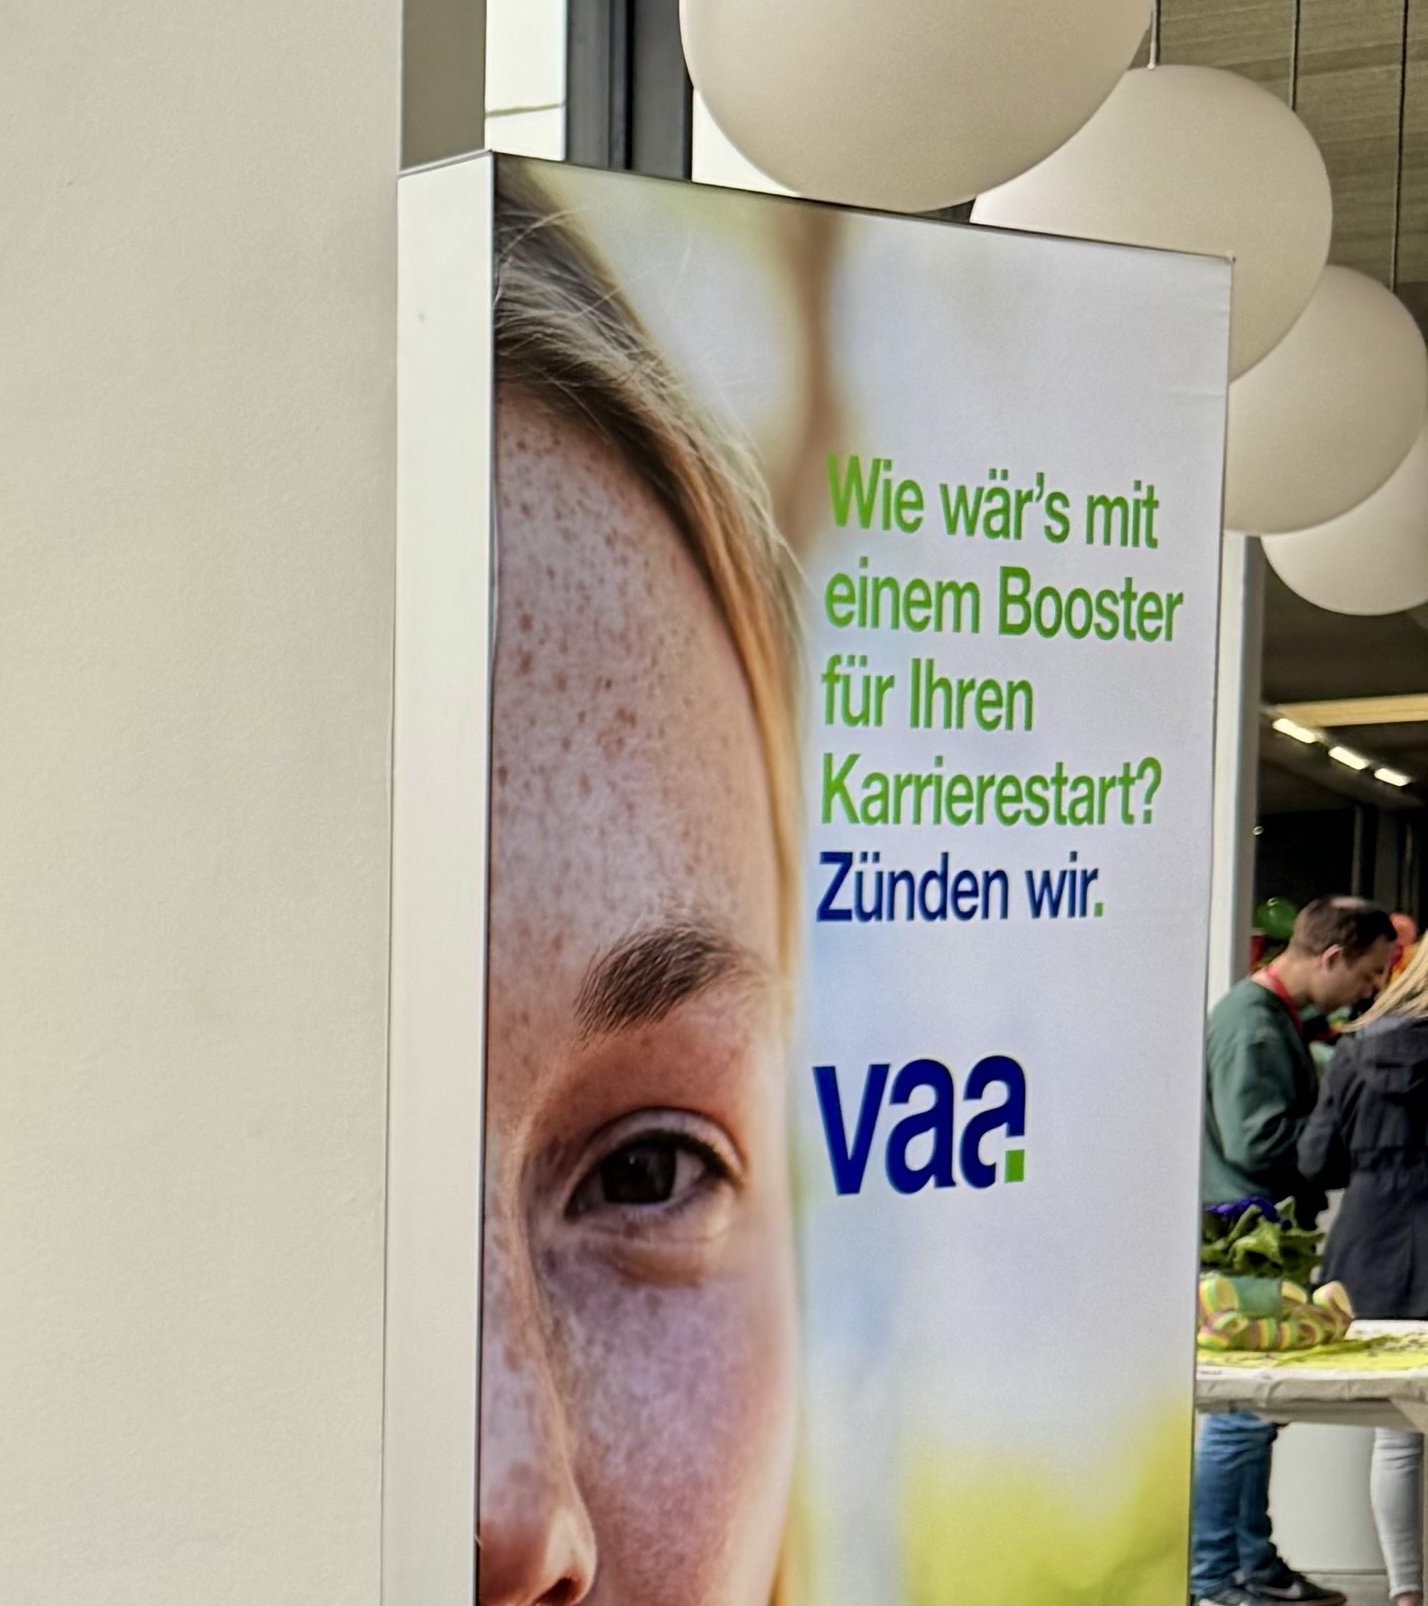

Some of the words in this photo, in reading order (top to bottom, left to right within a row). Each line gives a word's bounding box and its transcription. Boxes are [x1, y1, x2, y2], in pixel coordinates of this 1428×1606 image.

[825, 453, 924, 534] Wie
[1086, 480, 1159, 548] mit
[825, 556, 980, 634] einem
[999, 566, 1183, 642] Booster
[821, 654, 895, 728] für
[910, 658, 1034, 732] Ihren
[821, 753, 1162, 828] Karrierestart?
[817, 851, 1009, 923] Zünden
[1026, 852, 1104, 920] wir.
